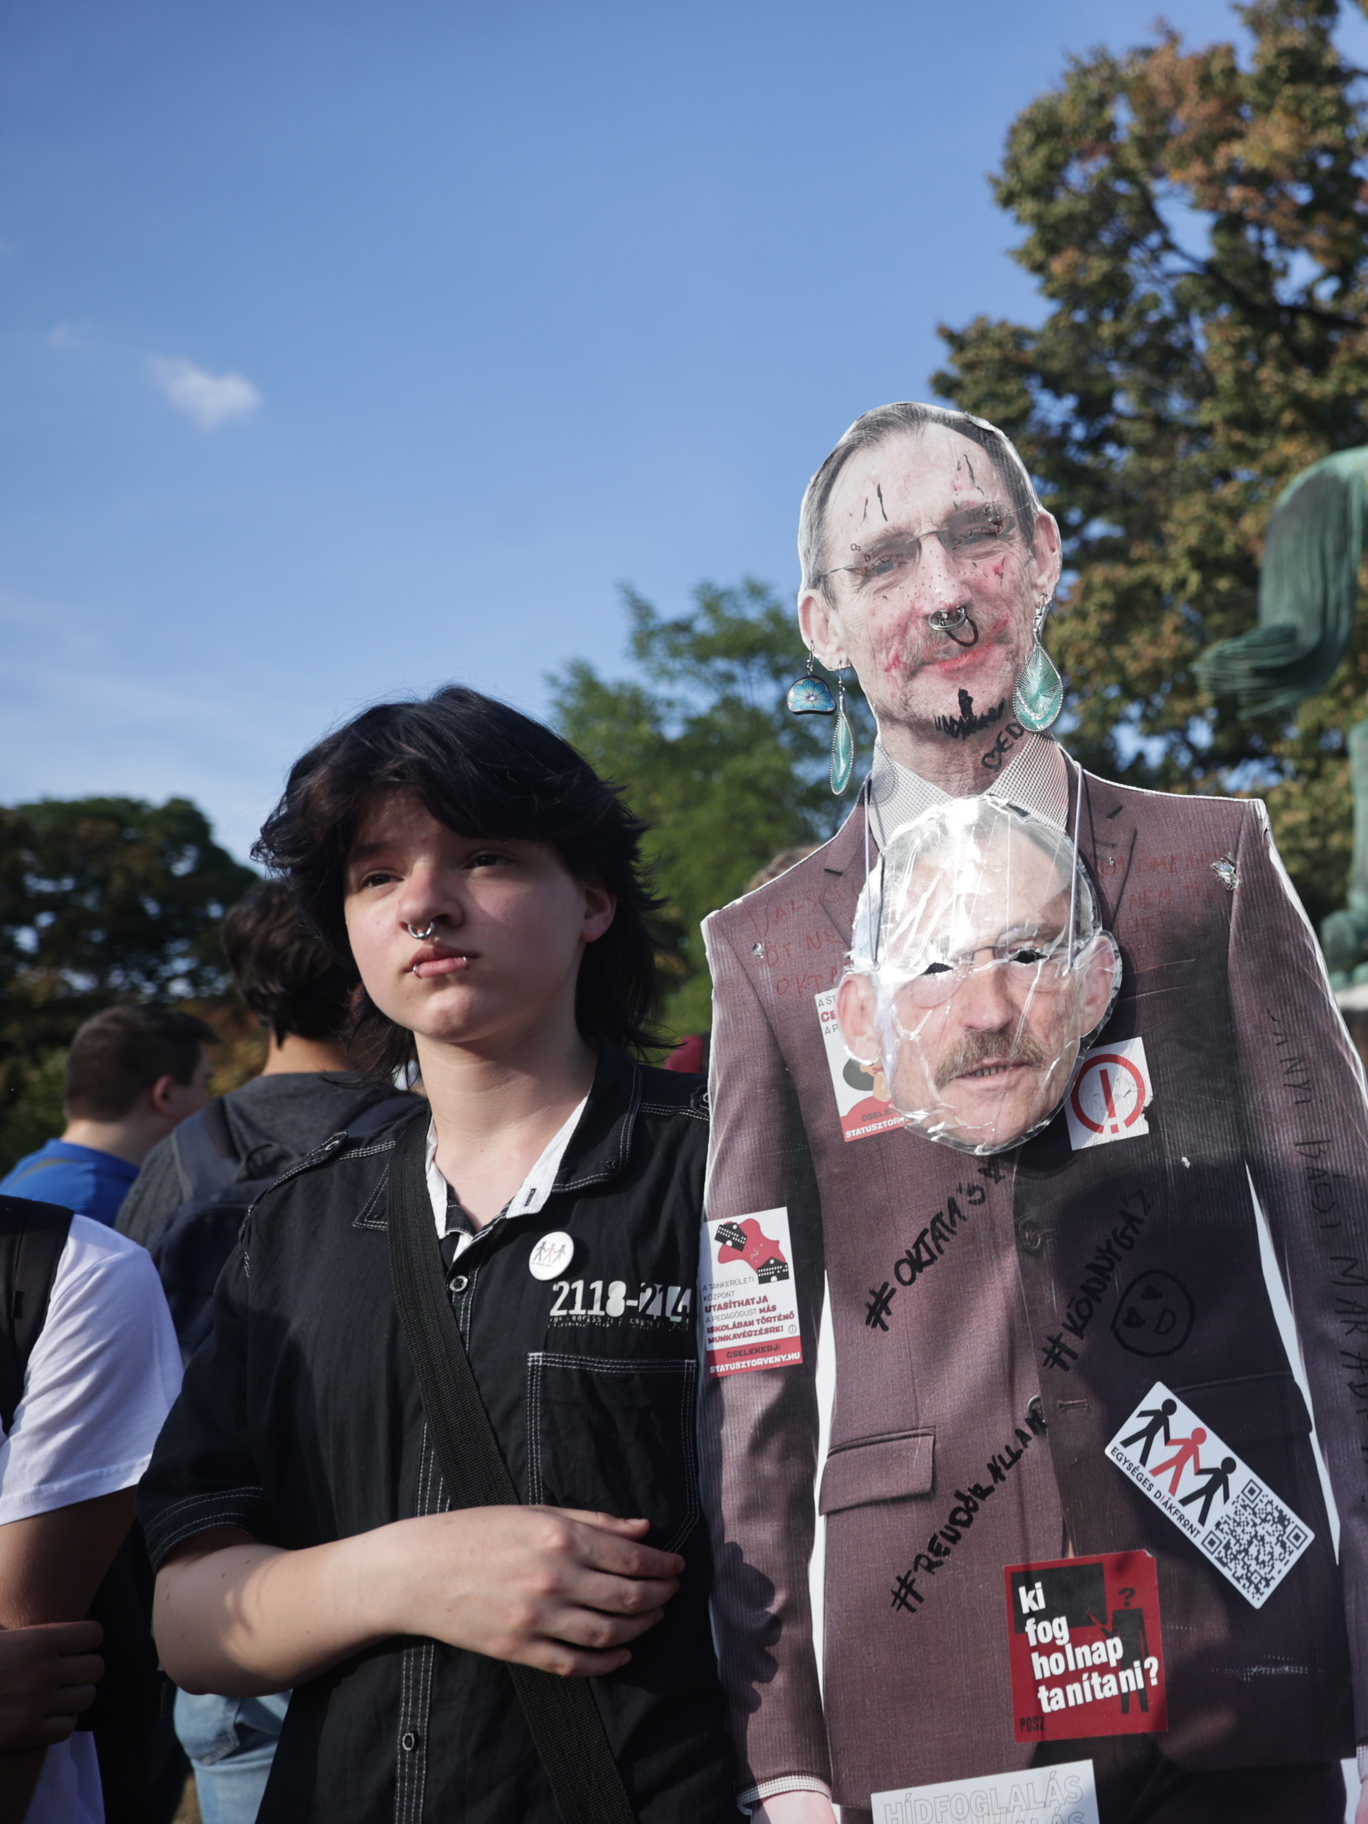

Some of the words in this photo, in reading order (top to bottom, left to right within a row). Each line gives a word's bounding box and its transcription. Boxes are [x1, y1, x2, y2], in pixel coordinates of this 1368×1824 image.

[703, 1290, 736, 1302] KÖZPONT
[704, 1295, 769, 1313] UTASÍTHATJA
[706, 1319, 755, 1335] ISKOLÁBAN
[756, 1311, 795, 1326] TÖRTÉNŐ
[711, 1308, 758, 1323] PEDAGÓGUST
[759, 1304, 777, 1314] MÁS
[707, 1325, 784, 1345] MUNKAVÉGZÉSRE!
[709, 1351, 801, 1375] STATUSZTORVENY.HU
[726, 1344, 781, 1360] CSELEKEDJ:
[1110, 1446, 1155, 1492] EGYSÉGES
[1153, 1489, 1202, 1539] DIÁKFRONT
[1018, 1581, 1046, 1614] ki
[1024, 1615, 1070, 1648] fog
[1030, 1636, 1124, 1681] holnap
[1037, 1656, 1159, 1714] tanítani?
[1020, 1716, 1047, 1732] PDSZ
[883, 1770, 1084, 1824] HÍDFOGLALÁS
